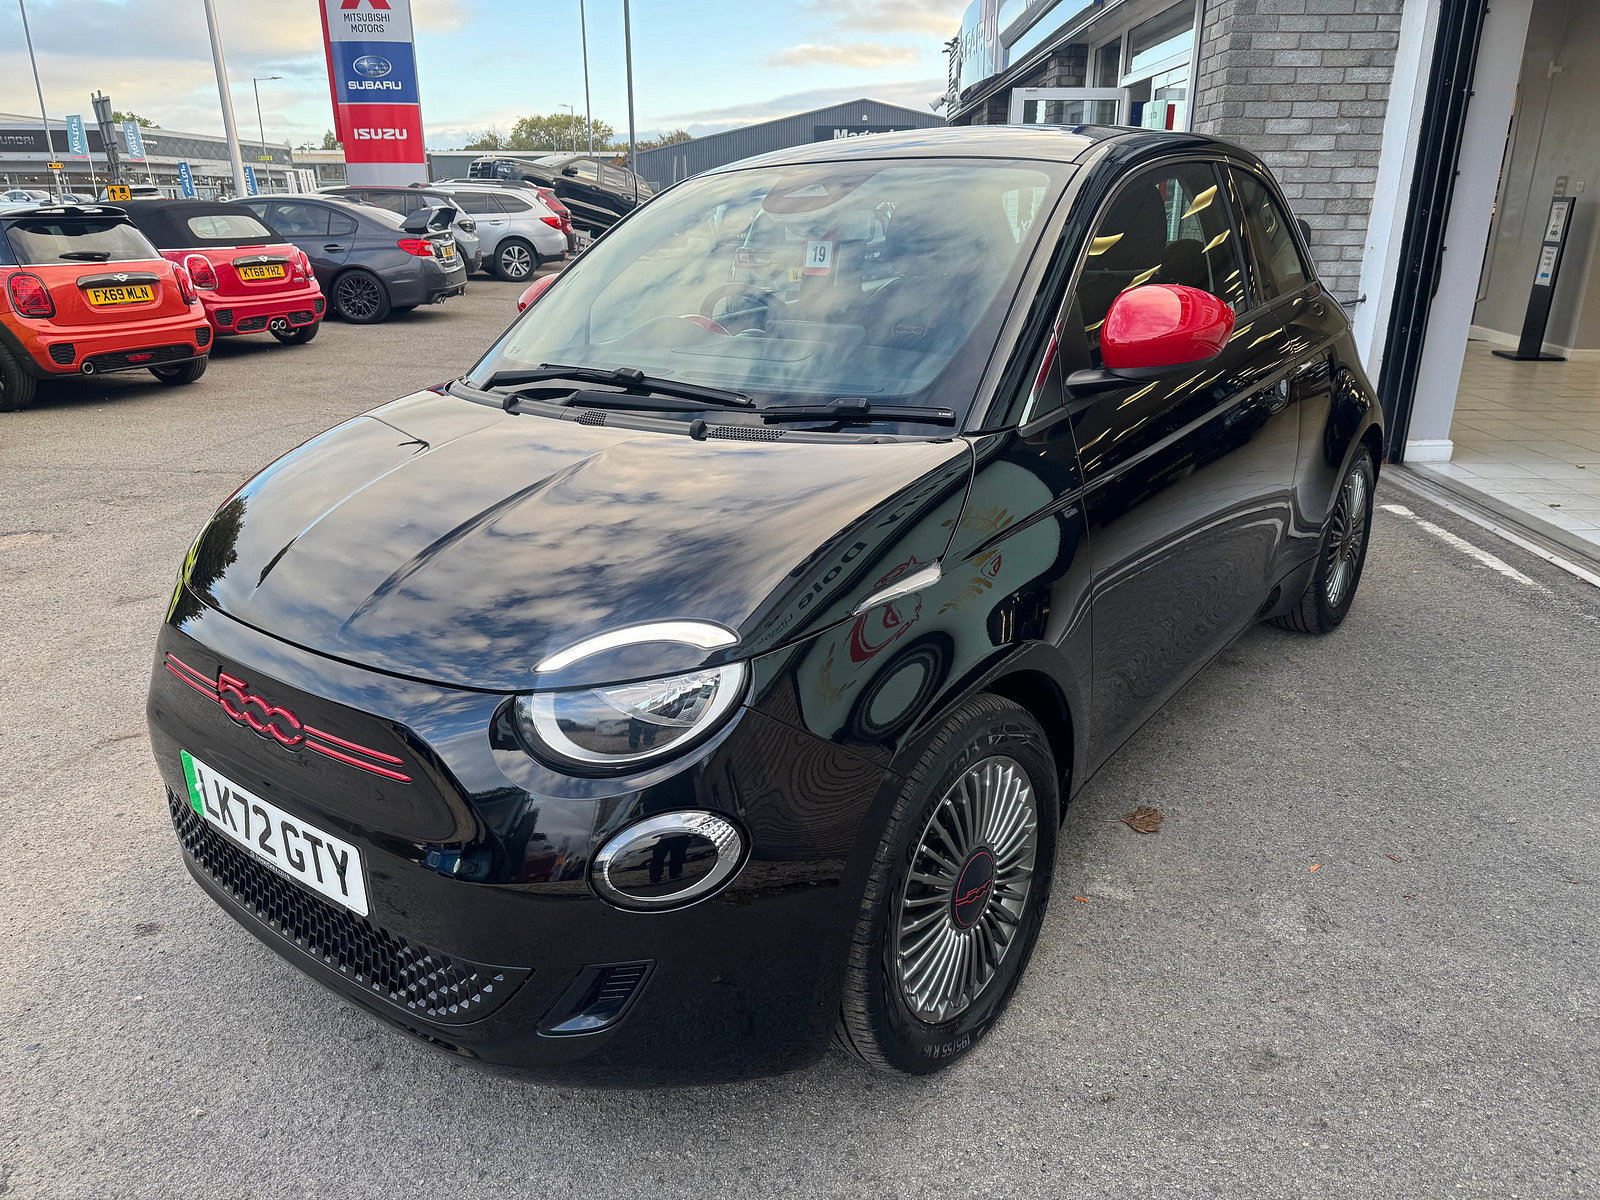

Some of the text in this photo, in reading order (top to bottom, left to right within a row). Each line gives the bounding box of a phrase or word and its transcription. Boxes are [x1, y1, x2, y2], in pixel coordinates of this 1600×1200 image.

[343, 13, 390, 22] MITSUBISHI
[350, 24, 385, 33] MOTORS
[348, 81, 402, 90] SUBARU
[353, 128, 408, 140] ISUZU
[812, 245, 826, 262] 19
[242, 265, 282, 278] KT68 YHZ
[93, 286, 150, 302] FX69 MLN
[217, 670, 304, 746] 500
[198, 768, 349, 897] LK72 GTY
[941, 1032, 971, 1058] 195/55
